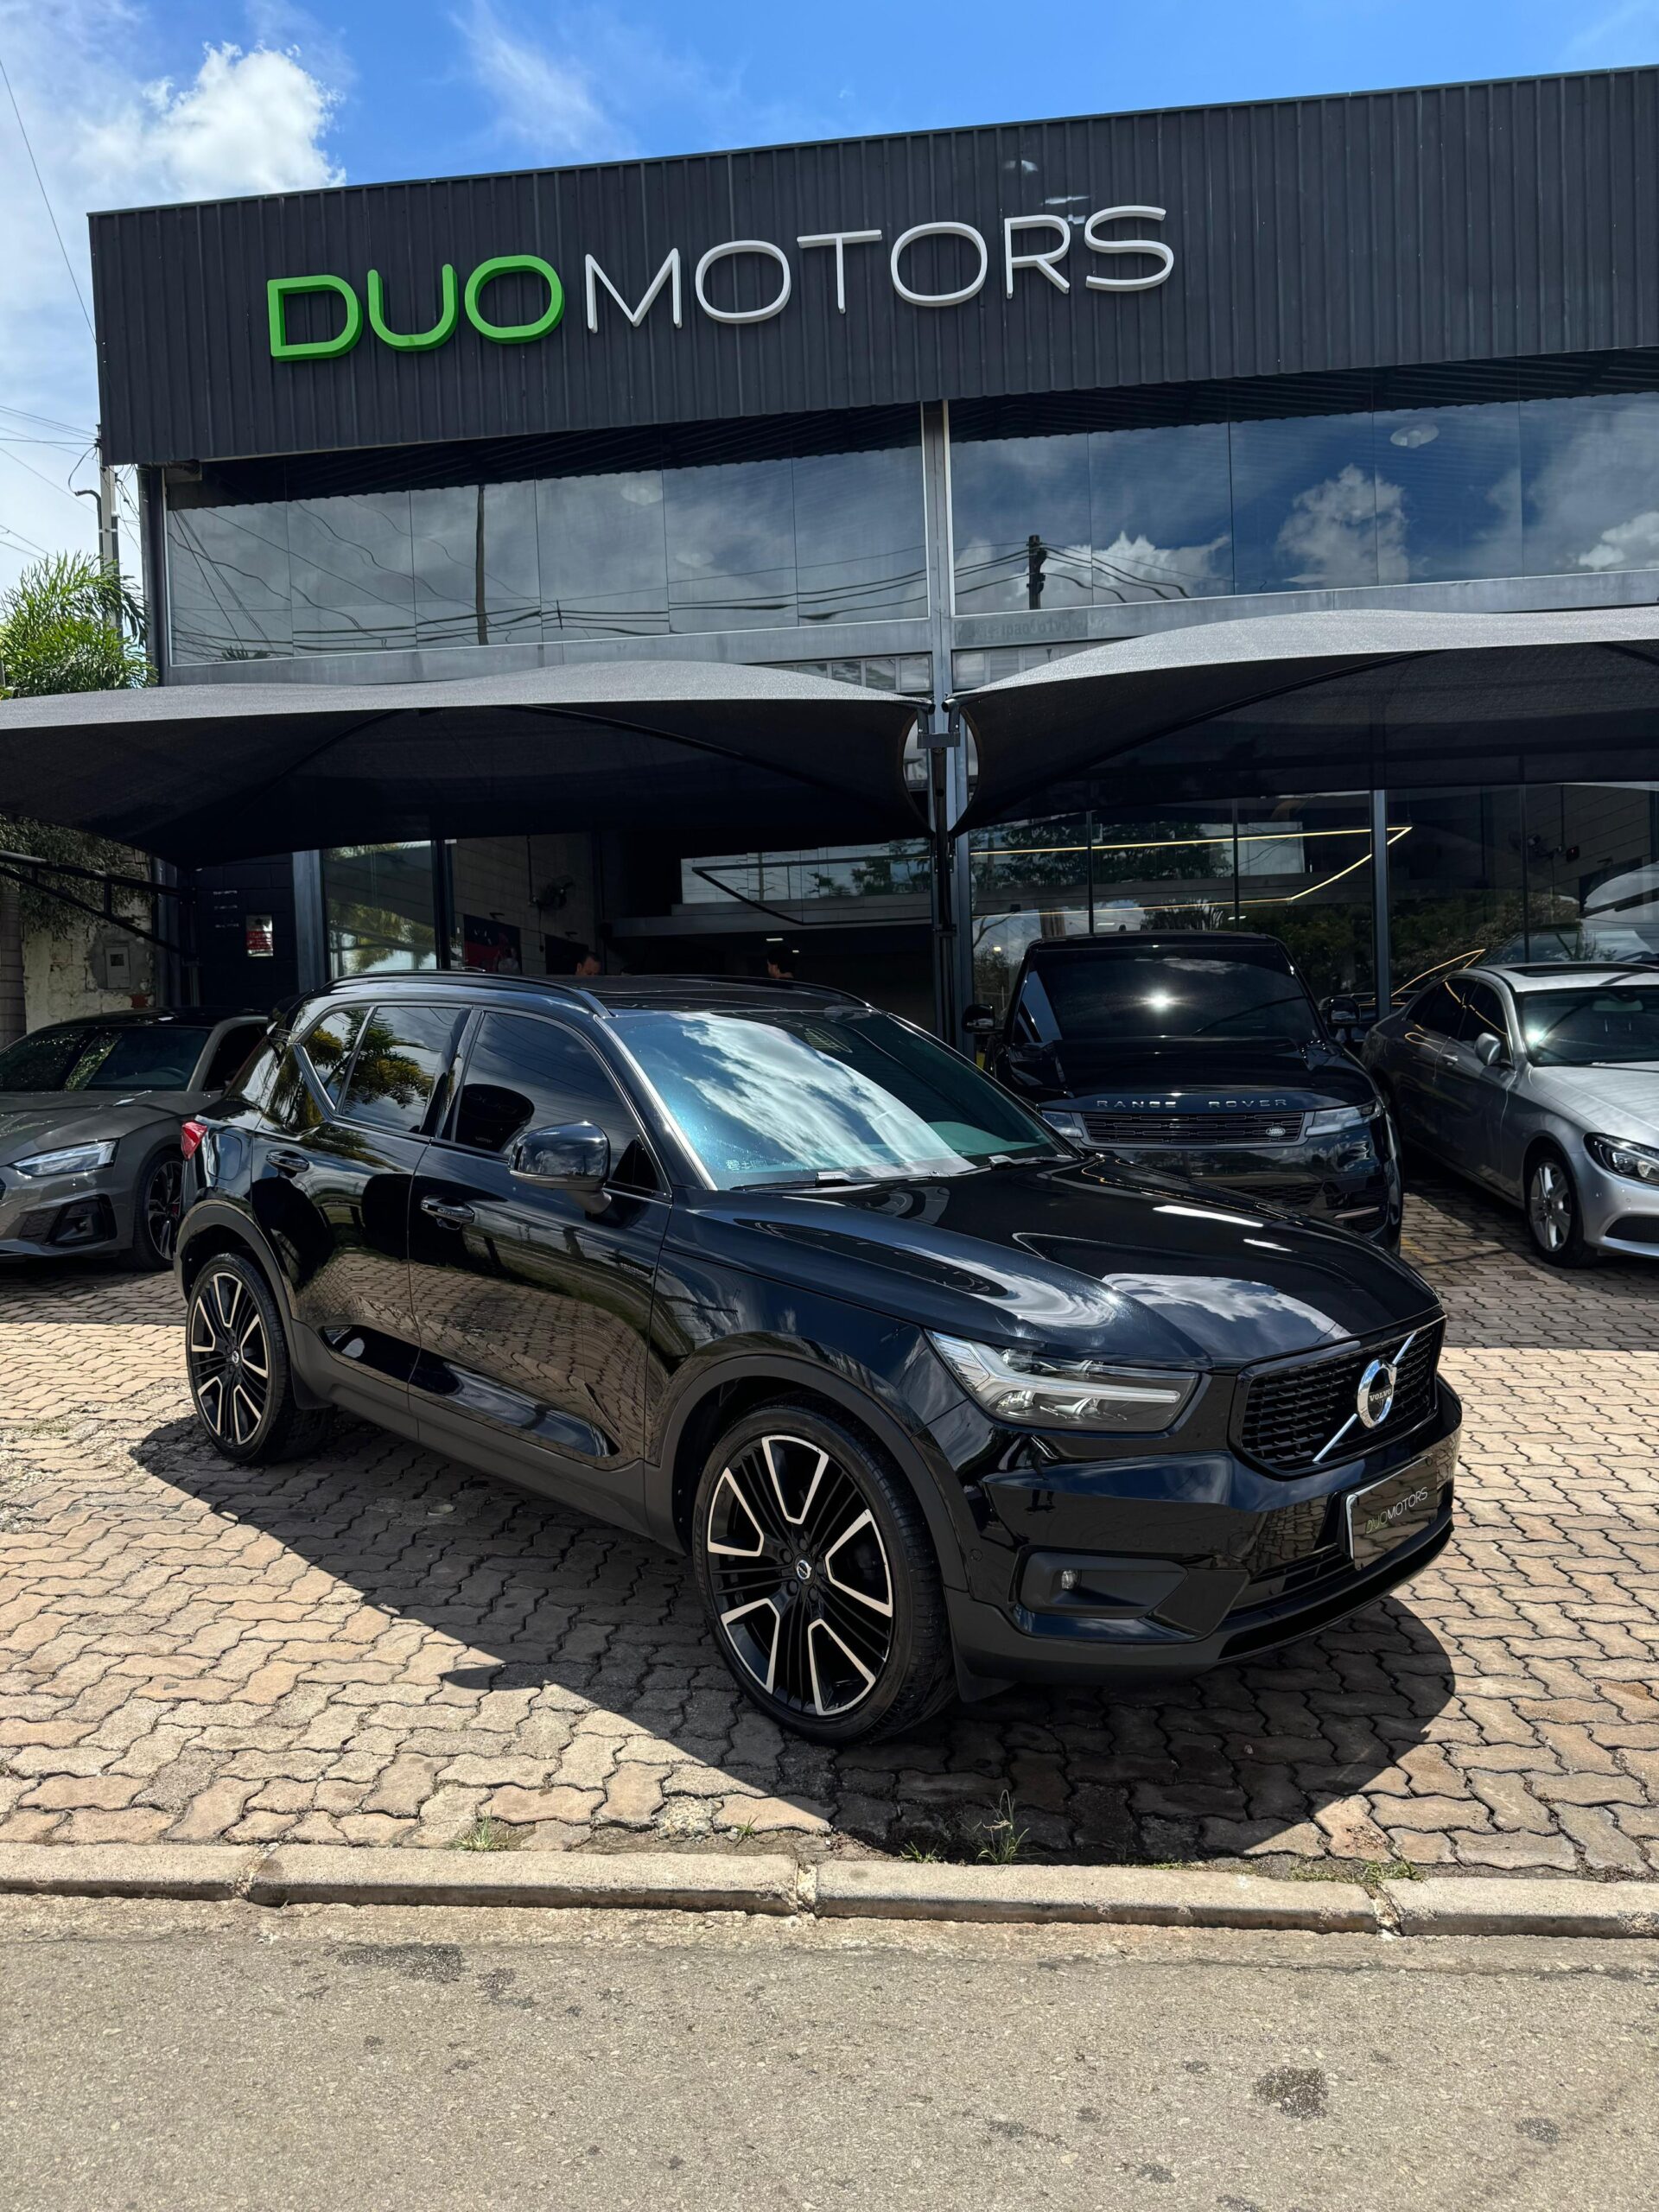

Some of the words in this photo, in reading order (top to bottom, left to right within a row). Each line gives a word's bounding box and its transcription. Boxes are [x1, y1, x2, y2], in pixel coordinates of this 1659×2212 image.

[266, 254, 565, 361] DUO
[584, 205, 1175, 334] MOTORS
[1096, 1100, 1178, 1109] RANGE
[1208, 1099, 1288, 1109] ROVER
[1369, 1389, 1392, 1402] VOLVO
[1387, 1486, 1428, 1520] MOTORS
